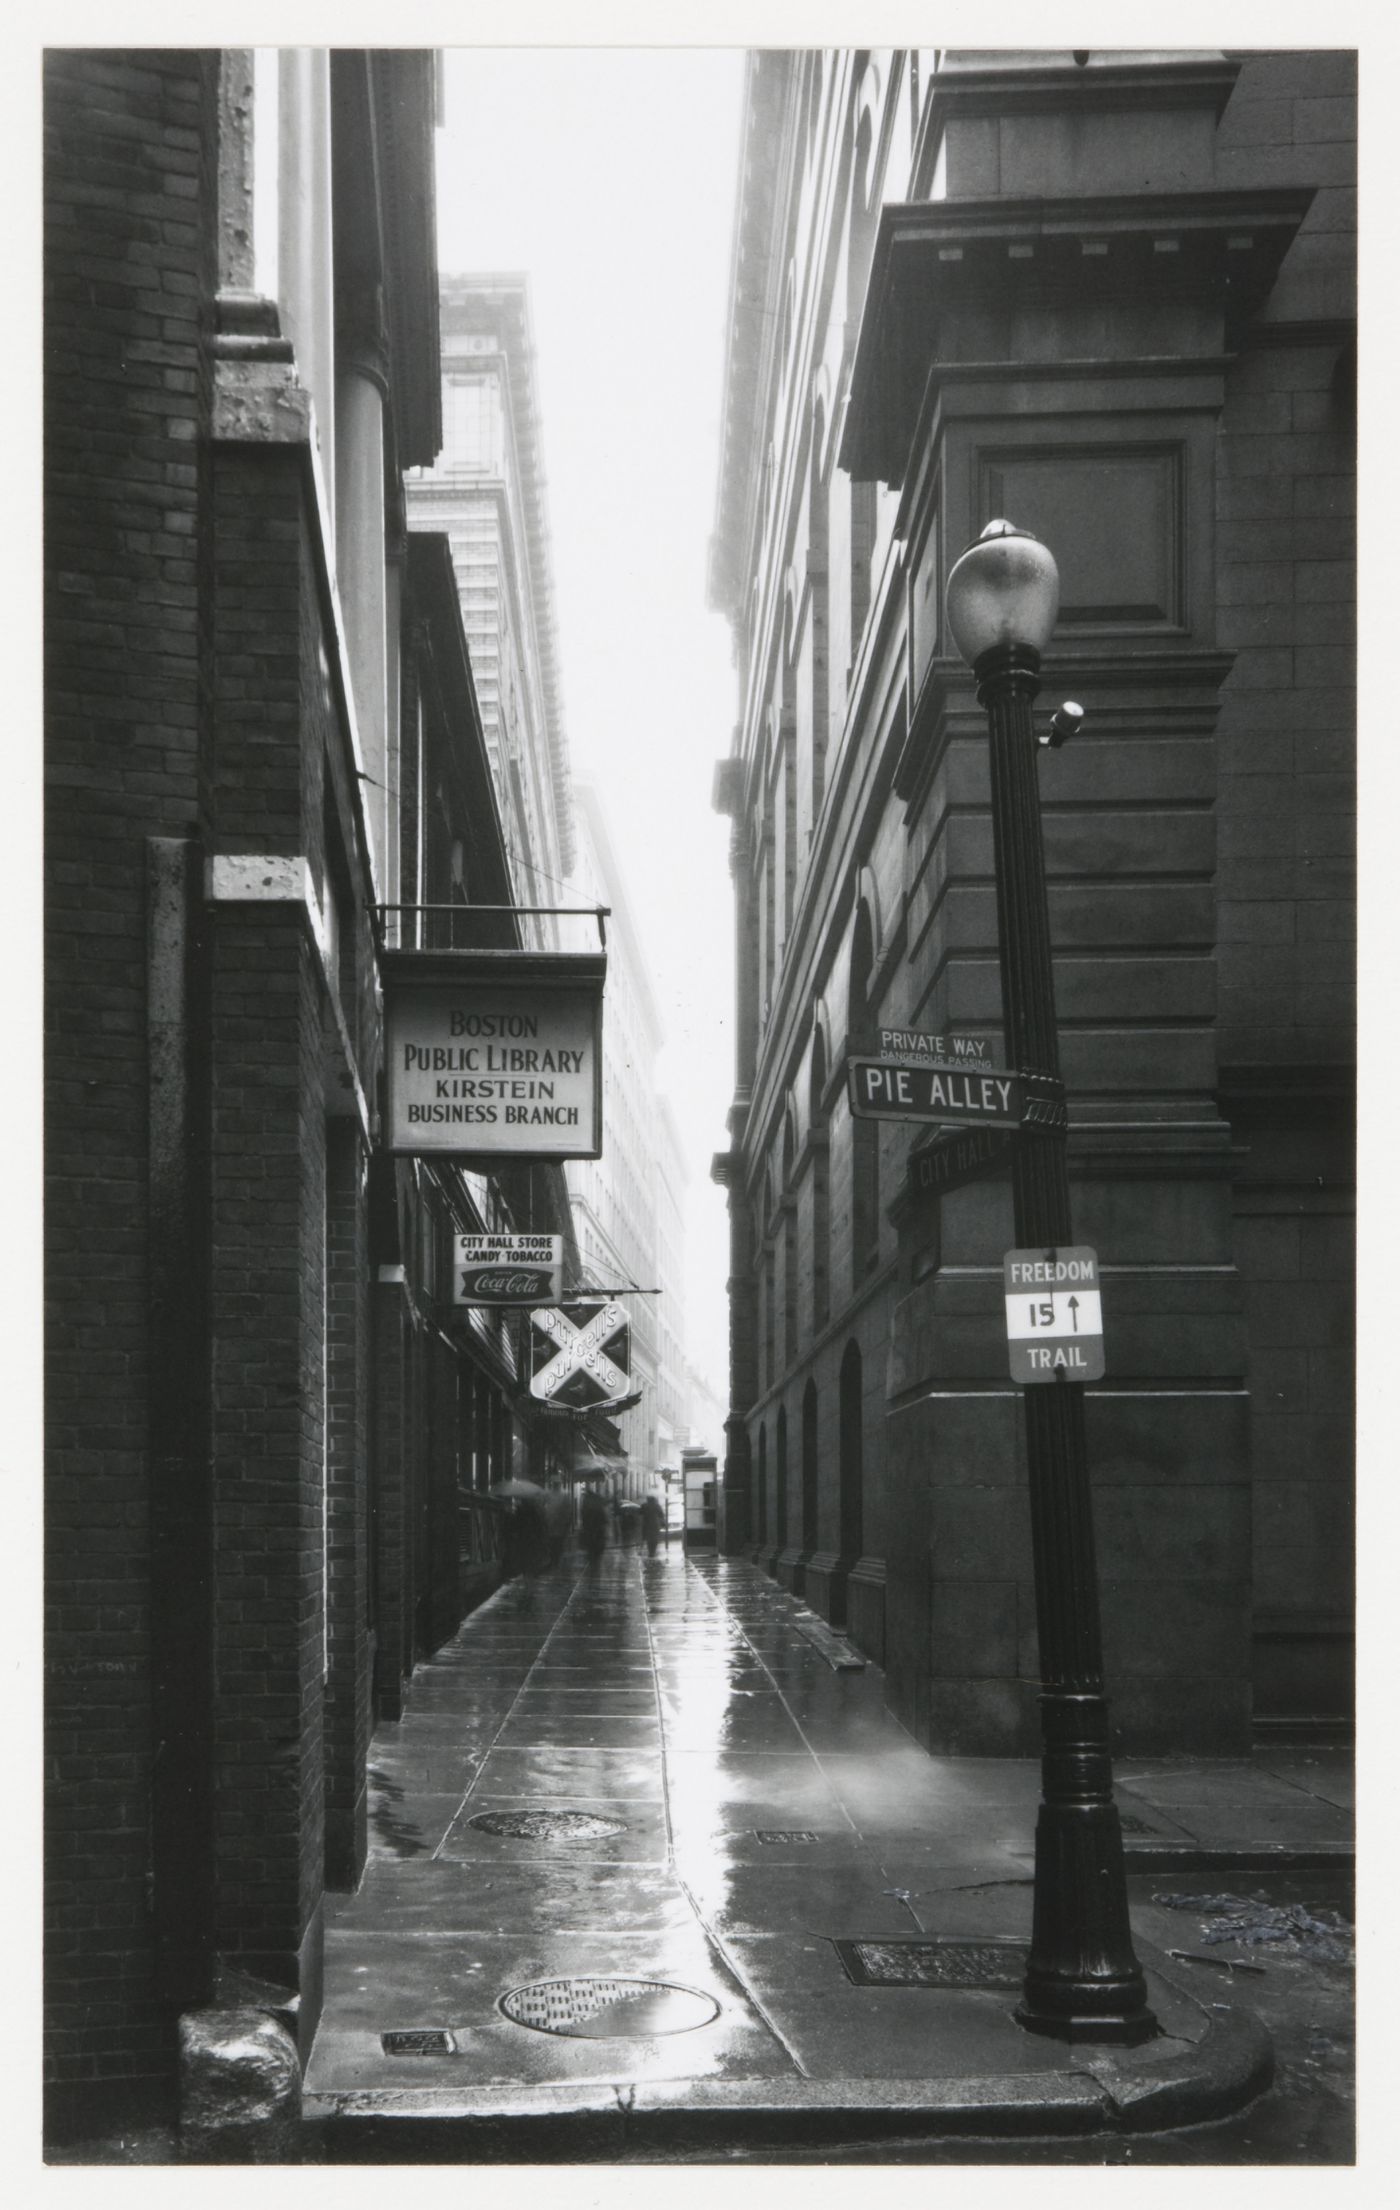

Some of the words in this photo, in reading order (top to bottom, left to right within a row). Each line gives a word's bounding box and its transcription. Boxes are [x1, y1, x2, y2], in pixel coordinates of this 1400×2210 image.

[450, 1011, 539, 1038] BOSTON
[881, 1031, 944, 1054] PRIVATE
[953, 1038, 986, 1057] WAY
[404, 1044, 479, 1071] PUBLIC
[487, 1044, 584, 1074] LIBRARY
[880, 1050, 945, 1065] DANGEROUS
[948, 1056, 992, 1069] PASSING
[436, 1079, 555, 1100] KIRSTEIN
[866, 1068, 913, 1104] PIE
[930, 1074, 1011, 1111] ALLEY
[408, 1104, 498, 1124] BUSINESS
[505, 1105, 579, 1126] BRANCH
[920, 1146, 950, 1187] CITY
[957, 1129, 997, 1171] HALL
[460, 1236, 483, 1249] CITY
[487, 1236, 514, 1249] HALL
[517, 1236, 553, 1249] STORE
[465, 1250, 502, 1262] CANDY
[504, 1250, 553, 1262] TOBACCO
[1011, 1261, 1094, 1283] FREEDOM
[474, 1273, 540, 1294] Coca-Cola
[1029, 1303, 1055, 1327] 15
[1027, 1347, 1087, 1369] TRAIL
